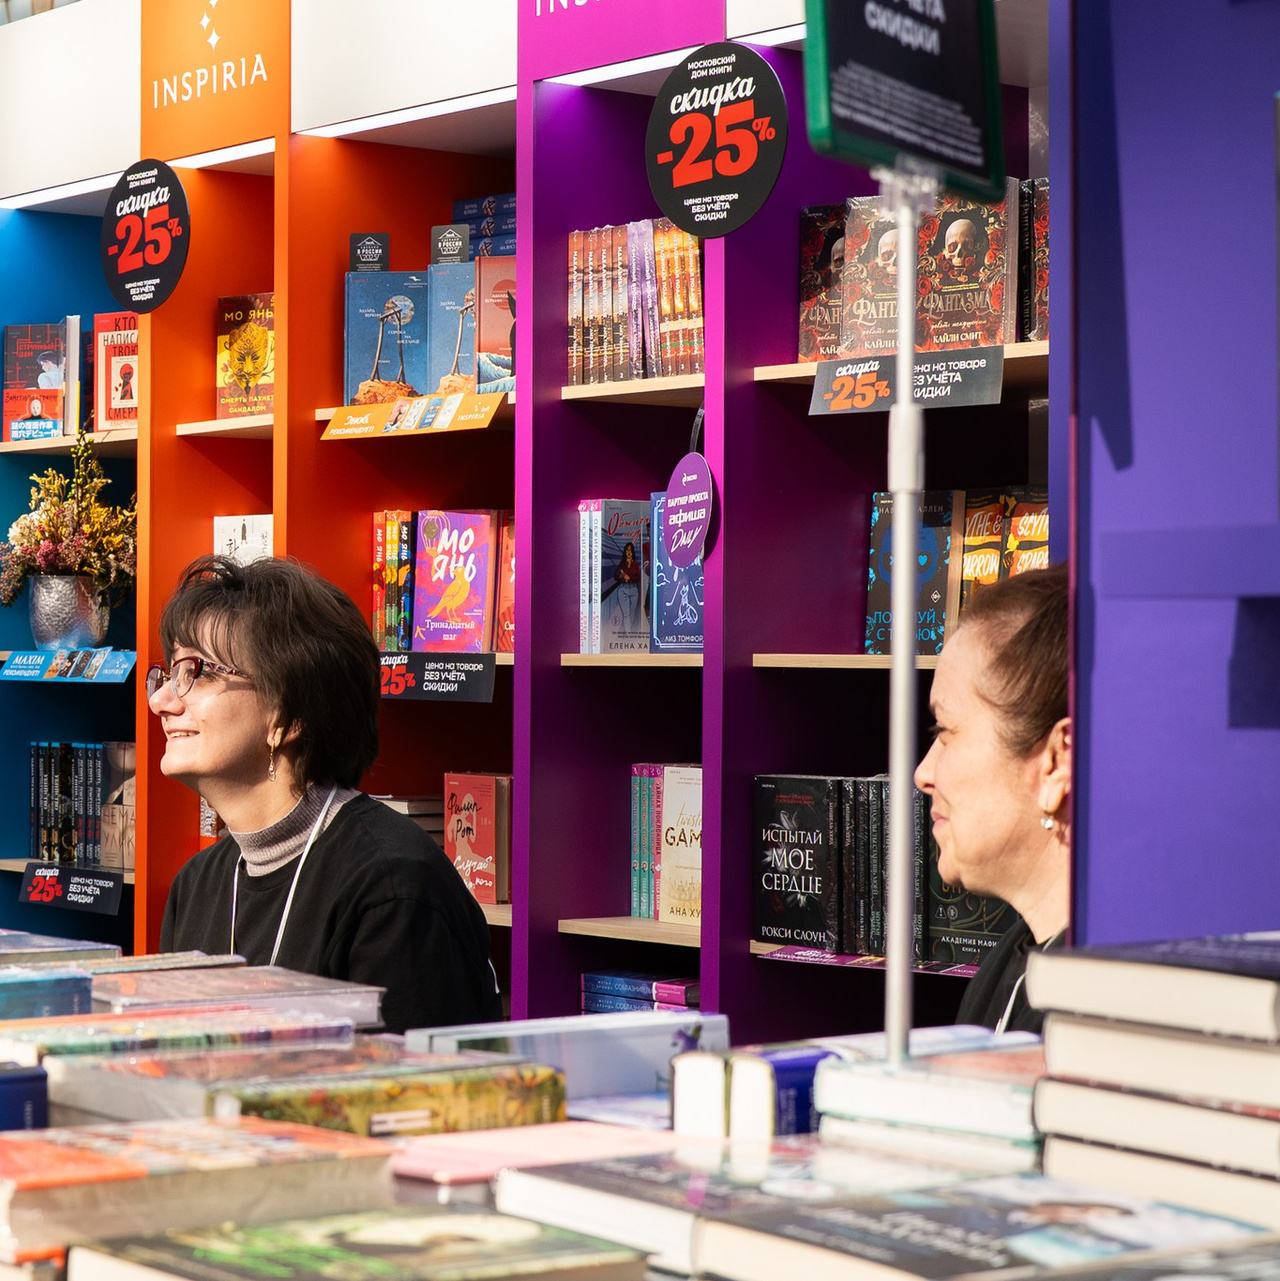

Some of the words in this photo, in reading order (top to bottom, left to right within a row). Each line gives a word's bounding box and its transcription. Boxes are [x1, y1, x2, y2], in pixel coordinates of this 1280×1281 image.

[864, 0, 940, 56] СКИДКИ
[688, 54, 736, 70] МОСКОВСКИЙ
[691, 68, 708, 80] ДОМ
[709, 65, 732, 77] КНИГИ
[153, 54, 268, 109] INSPIRIA
[670, 76, 756, 116] скидка
[657, 99, 776, 188] -25%
[127, 168, 158, 181] МОСКОВСКИЙ
[116, 186, 170, 218] скидка
[684, 197, 701, 206] цена
[703, 196, 711, 204] на
[713, 193, 738, 204] товаре
[691, 204, 706, 213] БЕЗ
[707, 199, 730, 212] УЧЁТА
[694, 210, 726, 222] СКИДКИ
[108, 204, 182, 274] -25%
[224, 311, 243, 321] МО
[248, 308, 273, 319] ЯНЬ
[115, 316, 136, 331] КТО
[103, 332, 138, 346] НАПИС
[864, 339, 895, 349] КАЙЛИ
[933, 333, 960, 344] КАЙЛИ
[961, 331, 983, 343] СМИТ
[836, 360, 881, 380] скидка
[914, 363, 932, 373] ена
[933, 362, 946, 371] на
[948, 358, 986, 370] товаре
[926, 373, 962, 385] УЧЁТА
[823, 372, 890, 411] -25%
[913, 385, 951, 398] КИДКИ
[221, 396, 247, 404] СМЕРТЬ
[248, 394, 274, 402] ПАХНЕТ
[228, 405, 266, 413] САНДАЛОМ
[668, 495, 688, 507] ПАРТНЕР
[688, 491, 709, 504] ПРОЕКТА
[669, 508, 706, 526] афиша
[438, 527, 474, 554] МО
[431, 554, 477, 582] ЯНЬ
[874, 608, 936, 624] ПОУЙ
[425, 619, 475, 630] Тринадцатый
[443, 633, 457, 641] шаг
[664, 634, 677, 642] ЛИЗ
[609, 641, 635, 650] ЕЛЕНА
[12, 655, 45, 665] MAXIM
[425, 662, 444, 671] цена
[456, 662, 484, 671] товаре
[380, 665, 416, 696] 25%
[424, 672, 439, 681] БЕЗ
[440, 671, 466, 681] УЧЁТА
[423, 682, 458, 692] СКИДКИ
[456, 819, 475, 841] Рот
[762, 828, 822, 845] ИСПЫТАЙ
[453, 855, 493, 877] Случай
[771, 848, 814, 871] МОЕ
[35, 868, 60, 880] скидка
[27, 876, 63, 902] -25%
[69, 884, 81, 892] БЕЗ
[81, 885, 100, 895] УЧЁТА
[762, 873, 822, 894] СЕРДЦЕ
[67, 893, 94, 903] СКИДКИ
[669, 906, 687, 916] АНА
[761, 925, 792, 939] РОКСИ
[794, 928, 826, 942] СЛОУН
[941, 935, 977, 946] АКАДЕМИЯ
